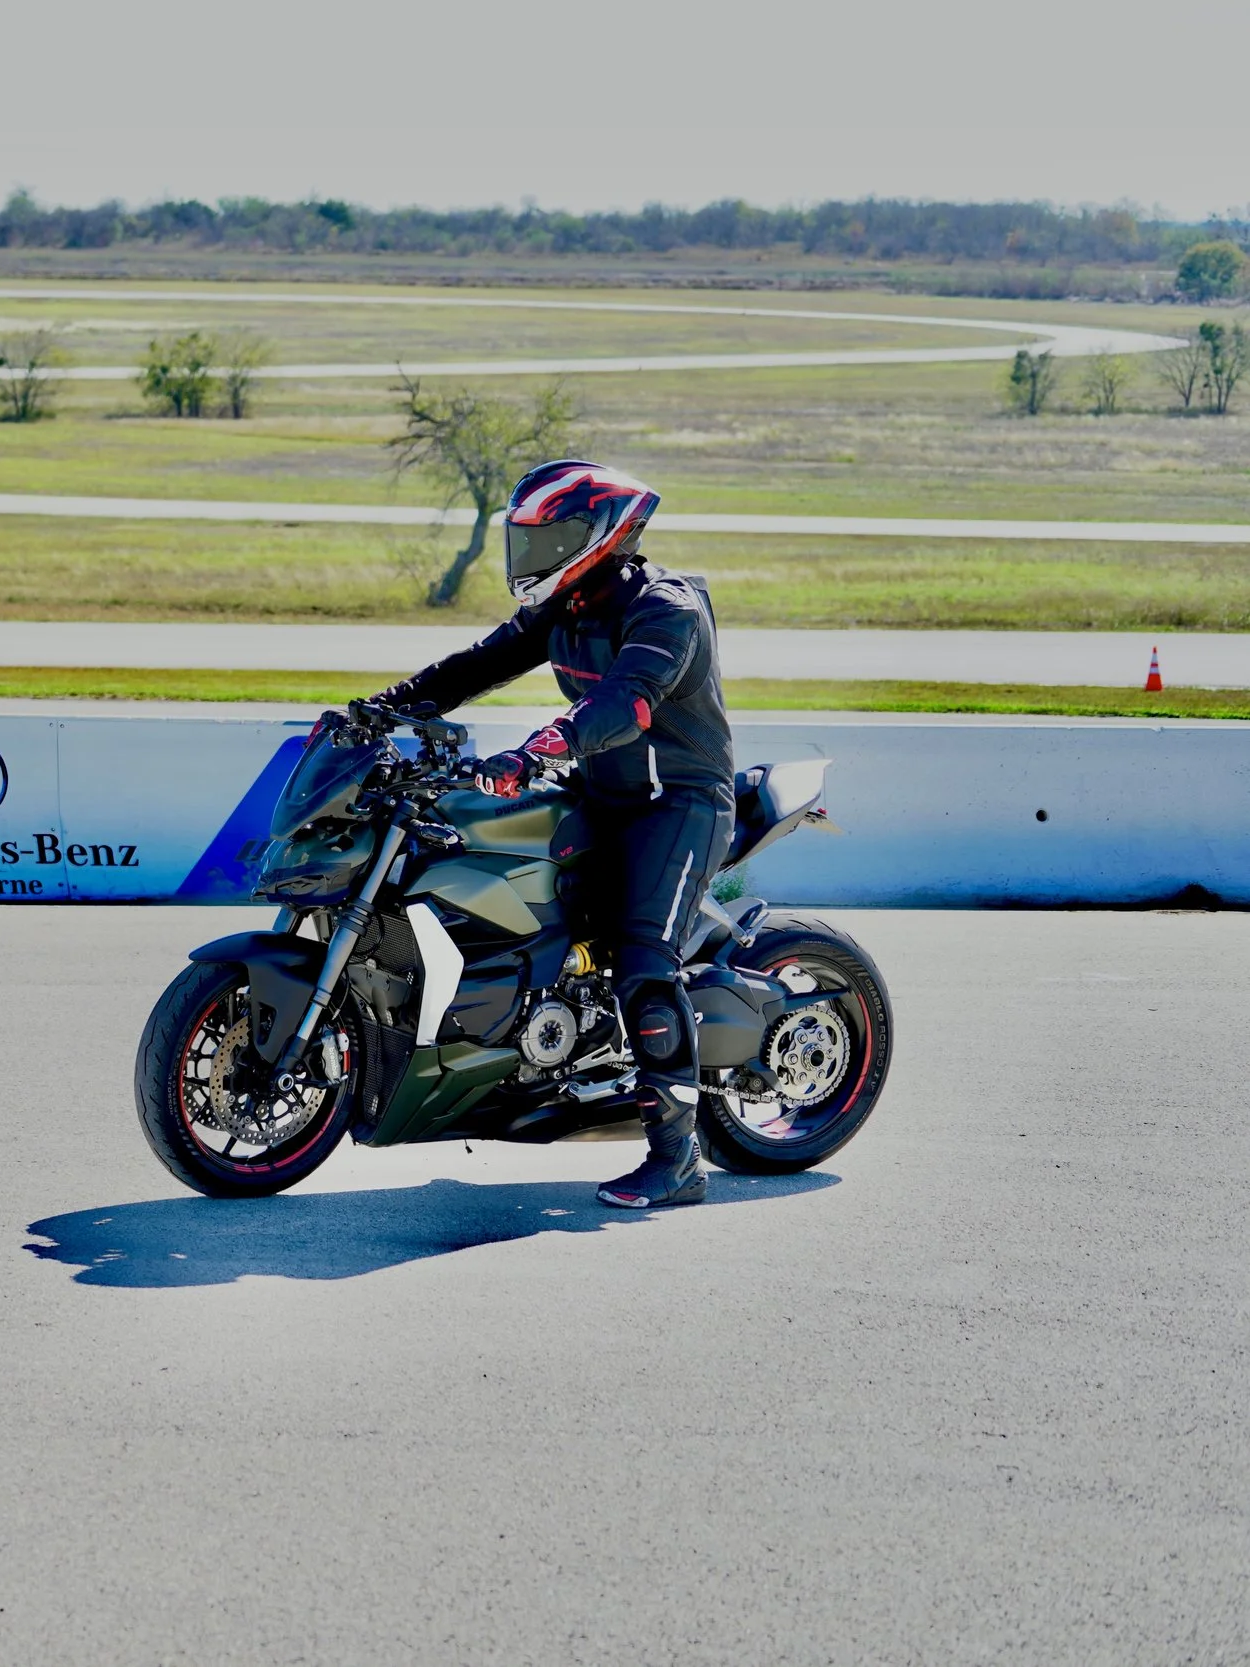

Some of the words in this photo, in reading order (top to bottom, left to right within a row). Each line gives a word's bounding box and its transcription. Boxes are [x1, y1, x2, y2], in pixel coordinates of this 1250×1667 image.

[494, 799, 535, 817] DUCATI
[864, 978, 885, 1022] DIABLO
[877, 1025, 886, 1067] ROSSO
